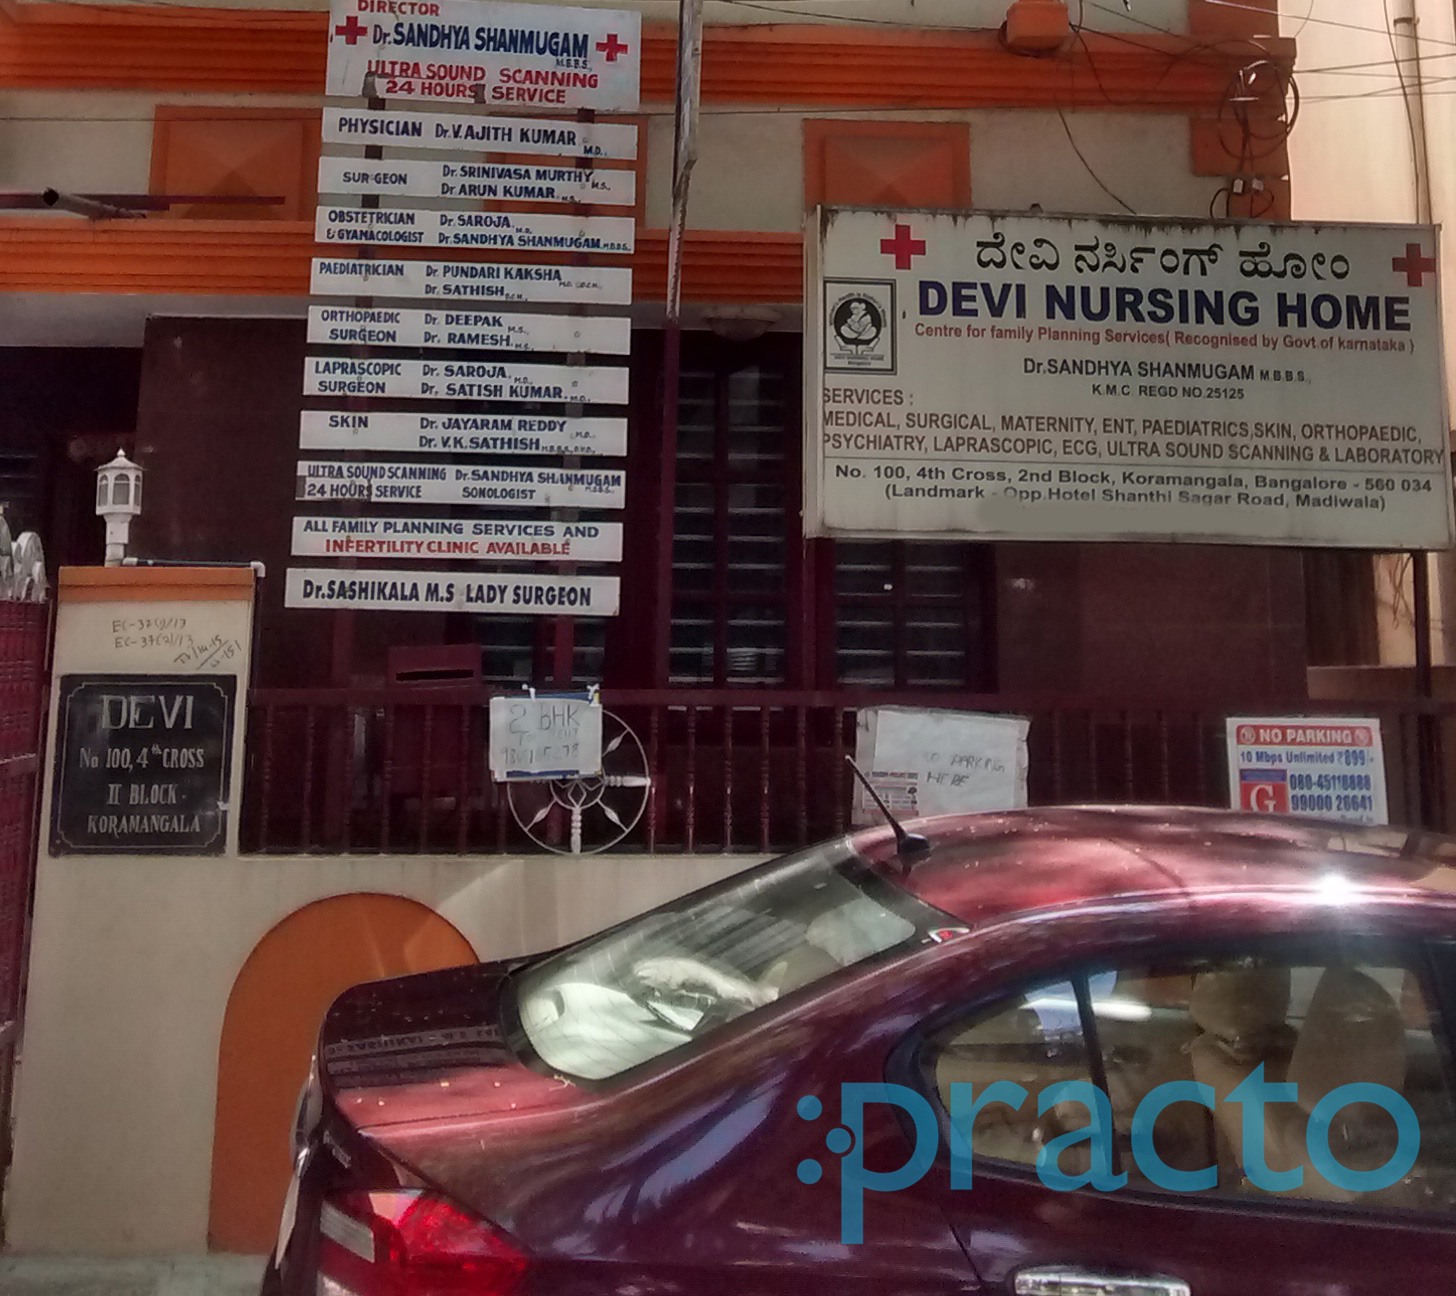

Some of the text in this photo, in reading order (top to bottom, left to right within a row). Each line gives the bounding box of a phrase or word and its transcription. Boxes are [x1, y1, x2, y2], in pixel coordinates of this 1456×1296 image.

[358, 0, 440, 16] DIRECTOR
[474, 27, 589, 58] SHANMUGAM
[368, 60, 598, 88] ULTRA SOUND SCANNING
[386, 80, 565, 103] 24 HOURS SERVICE
[339, 117, 422, 136] PHYSICIAN
[520, 128, 576, 145] KUMAR
[343, 172, 407, 184] SURGEON
[460, 166, 530, 180] SRINIVASA
[536, 169, 593, 182] MURTHY
[458, 184, 497, 197] ARUN
[503, 186, 555, 198] KUMAR
[328, 210, 415, 224] OBSTETRICIAN
[453, 234, 514, 246] SANDHYA
[518, 235, 601, 249] SHANMUGAM
[976, 232, 1060, 272] ದೇವಿ
[319, 262, 404, 276] PAEDIATRICIAN
[443, 266, 500, 279] PUNDARI
[504, 268, 561, 281] KAKSHA
[443, 284, 504, 296] SATHISH
[918, 280, 1026, 319] DEVI
[1045, 285, 1260, 327] NURSING
[1277, 292, 1411, 332] HOME
[321, 310, 400, 323] ORTHOPAEDIC
[445, 314, 503, 327] DEEPAK
[329, 329, 396, 343] SURGEON
[915, 323, 962, 337] Centre
[966, 324, 986, 338] for
[990, 325, 1033, 342] family
[1038, 327, 1100, 345] Planning
[1175, 331, 1257, 349] Recognised
[1262, 335, 1278, 350] by
[1339, 337, 1405, 351] karnataka
[315, 361, 401, 375] LAPRASCOPIC
[1138, 361, 1254, 380] SHANMUGAM
[318, 381, 385, 394] SURGEON
[446, 383, 502, 397] SATISH
[1139, 385, 1178, 397] REGD
[329, 415, 368, 428] SKIN
[442, 418, 512, 431] JAYARAM
[518, 420, 566, 432] REDDY
[824, 411, 900, 430] MEDICAL,
[906, 413, 996, 433] SURGICAL,
[1001, 416, 1097, 435] MATERNITY,
[1102, 418, 1137, 436] ENT,
[1301, 423, 1422, 444] ORTHOPAEDIC,
[824, 434, 1444, 464] PSYCHIATRY, LAPRASCOPIC, ECG, ULTRA SOUND SCANNING & LABORATORY
[308, 465, 446, 480] ULTRA SOUND SCANNING
[538, 473, 621, 486] SHANMUGAM
[874, 466, 910, 481] 100,
[916, 466, 945, 480] 4th
[952, 467, 1012, 483] Cross,
[1018, 469, 1052, 482] 2nd
[1058, 470, 1116, 486] Block,
[1122, 472, 1248, 489] Koramangala,
[1255, 475, 1347, 491] Bangalore
[1365, 478, 1395, 491] 560
[1401, 479, 1432, 492] 034
[307, 484, 326, 496] 24
[375, 485, 422, 498] SERVICE
[885, 484, 984, 500] (Landmark
[1102, 488, 1172, 503] Shanthi
[1178, 491, 1232, 506] Sagar
[1237, 492, 1289, 508] Road,
[1296, 494, 1385, 511] Madiwala)
[304, 520, 599, 538] ALL FAMILY PLANNING SERVICES AND
[326, 539, 570, 555] INFERTILITY CLINIC AVAILABLE
[466, 584, 508, 603] LADY
[512, 585, 591, 606] SURGEON
[101, 695, 194, 729] DEVI
[509, 704, 529, 734] 2
[1259, 728, 1352, 743] NO PARKING
[163, 748, 204, 768] CROSS
[1256, 751, 1282, 765] Mbps
[1286, 751, 1334, 763] Unlimited
[106, 784, 178, 804] II BLOCK
[88, 814, 200, 838] KORAMANGALA
